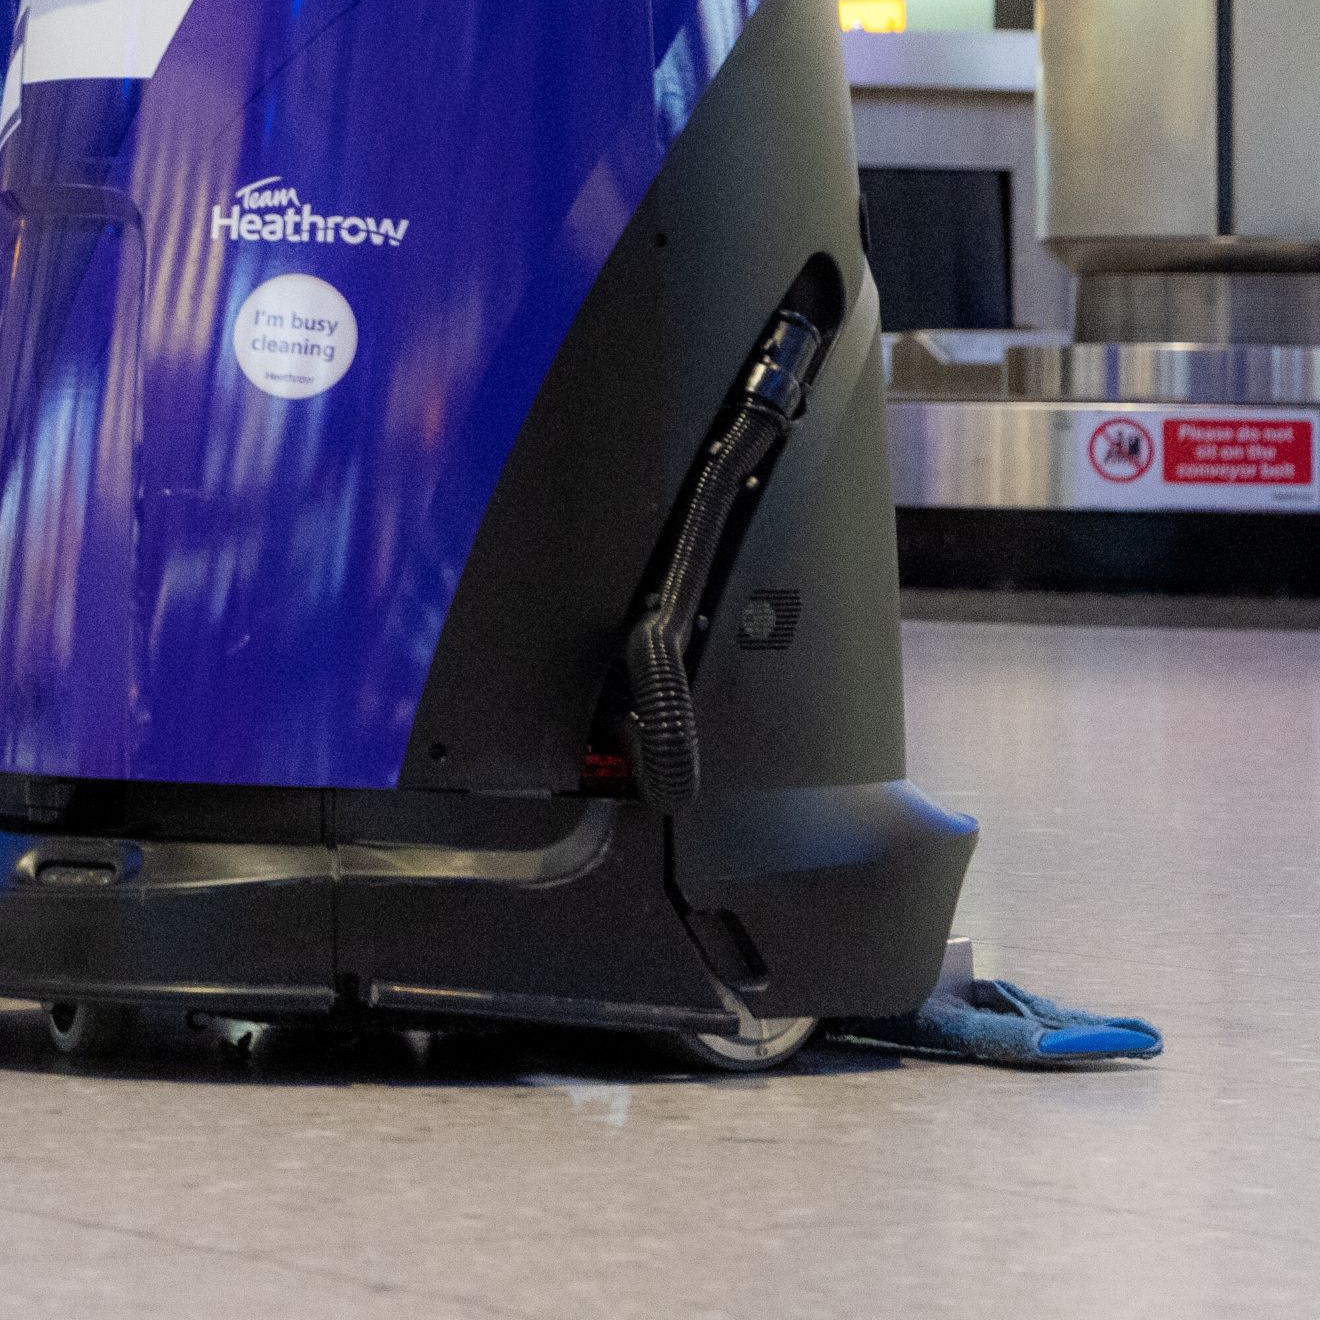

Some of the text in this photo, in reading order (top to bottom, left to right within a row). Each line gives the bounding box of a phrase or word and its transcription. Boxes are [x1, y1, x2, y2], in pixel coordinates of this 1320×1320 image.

[235, 176, 301, 210] Team
[210, 203, 410, 247] Heathrow
[254, 310, 340, 337] I'm busy
[251, 335, 336, 363] cleaning
[1178, 424, 1295, 443] Please do not
[1219, 446, 1245, 460] on
[1246, 443, 1277, 461] the
[1177, 462, 1295, 481] conveyor belt
